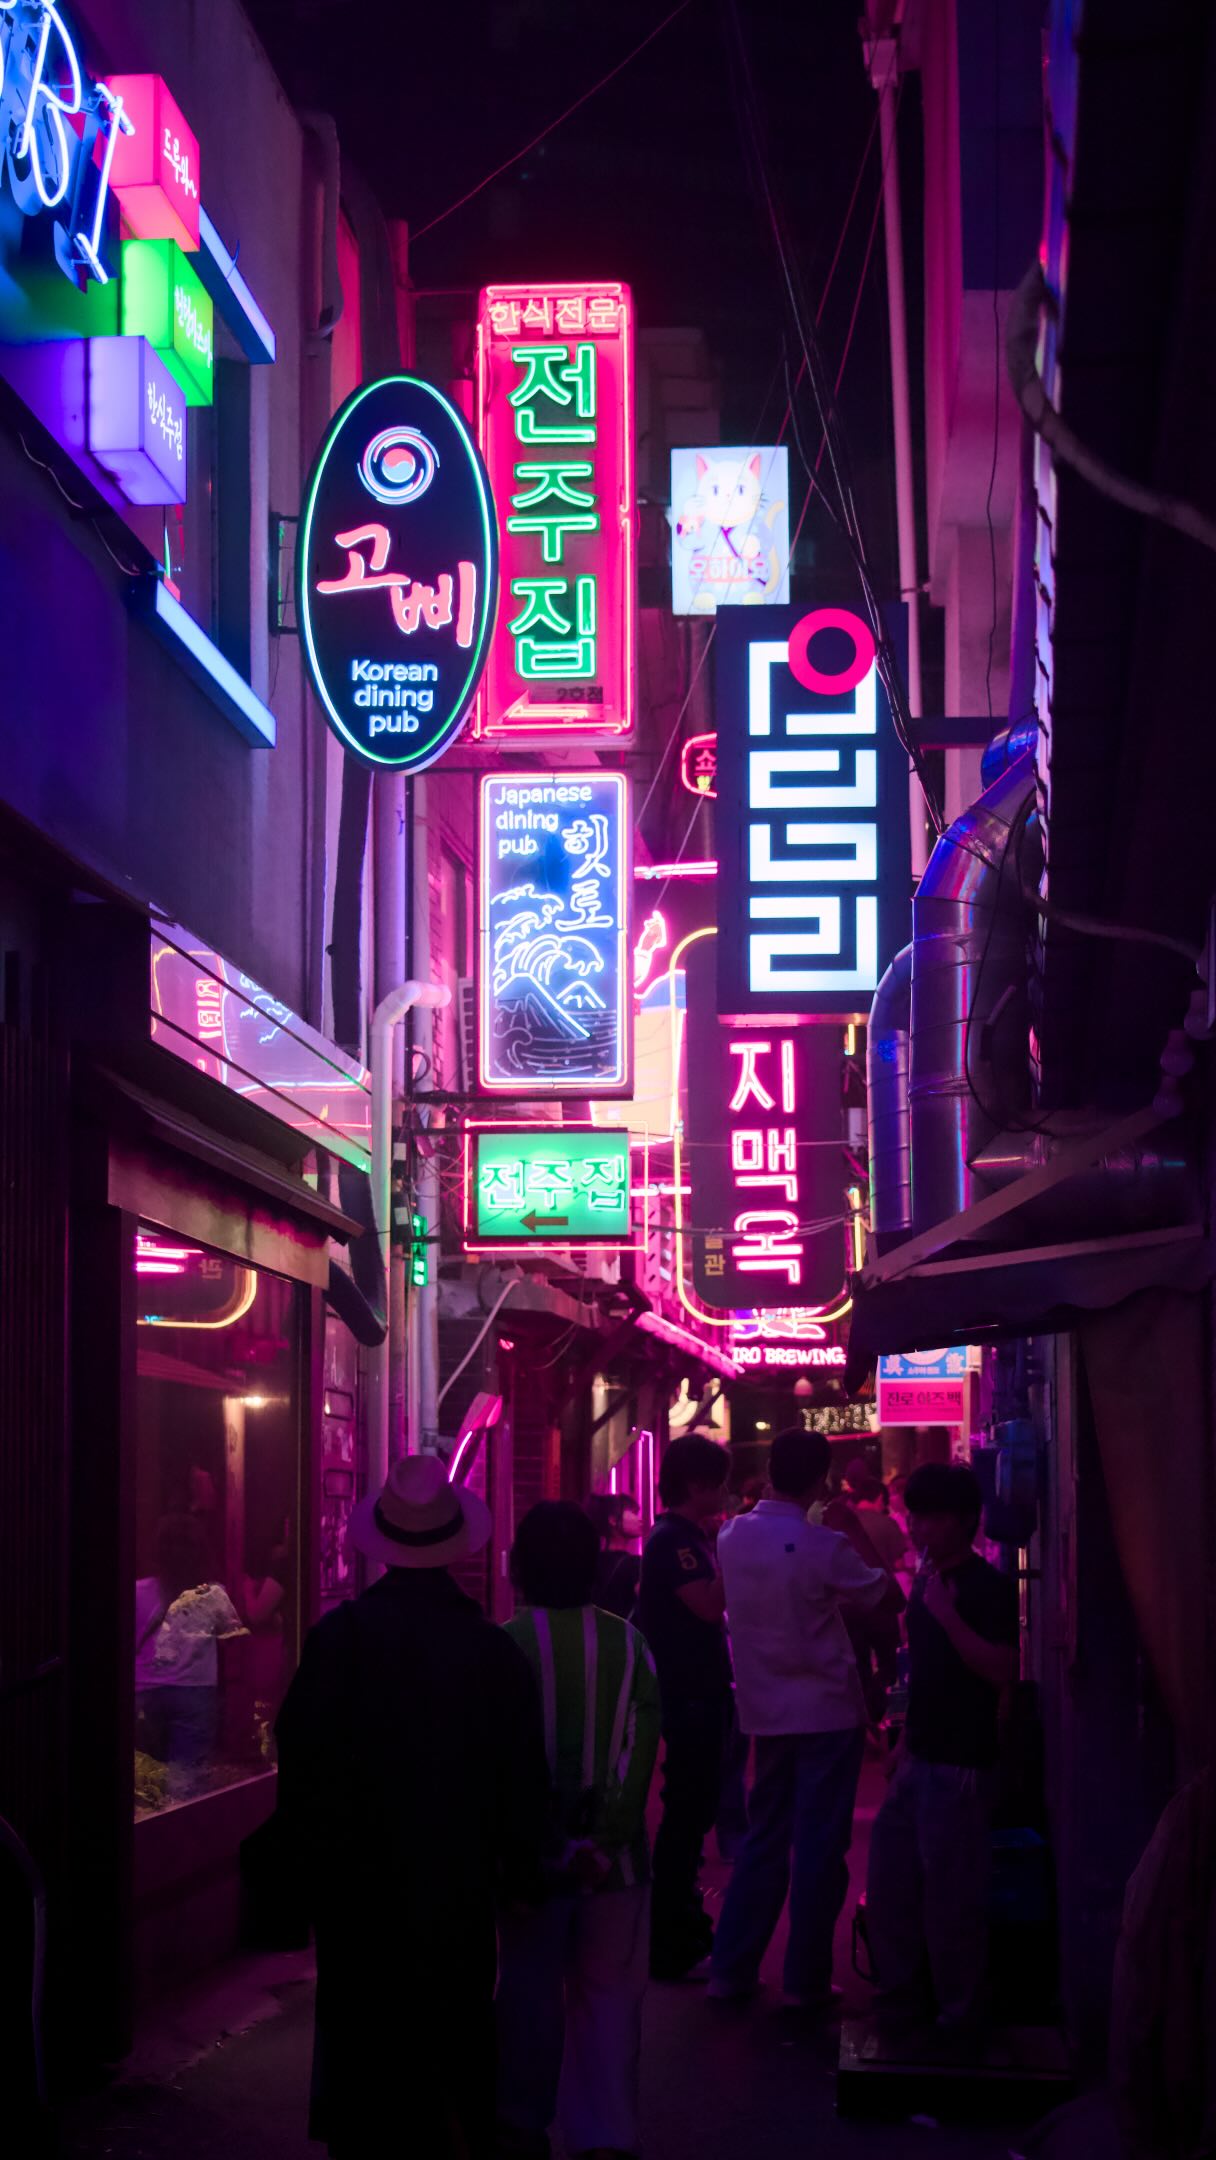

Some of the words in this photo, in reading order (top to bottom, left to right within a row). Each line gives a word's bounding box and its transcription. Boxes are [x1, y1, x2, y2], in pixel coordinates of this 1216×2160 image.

[489, 298, 619, 335] 한식전문
[147, 381, 183, 461] 한식주점
[507, 343, 601, 681] 전주집
[316, 523, 478, 649] 고삐
[352, 659, 438, 682] Korean
[354, 684, 434, 711] dining
[369, 710, 419, 737] pub
[495, 785, 592, 808] Japanese
[496, 809, 558, 832] dining
[498, 832, 539, 859] pub
[728, 1040, 804, 1285] 지맥옥
[480, 1155, 625, 1212] 전주집
[887, 1391, 914, 1406] 진로
[676, 1548, 698, 1570] 5
